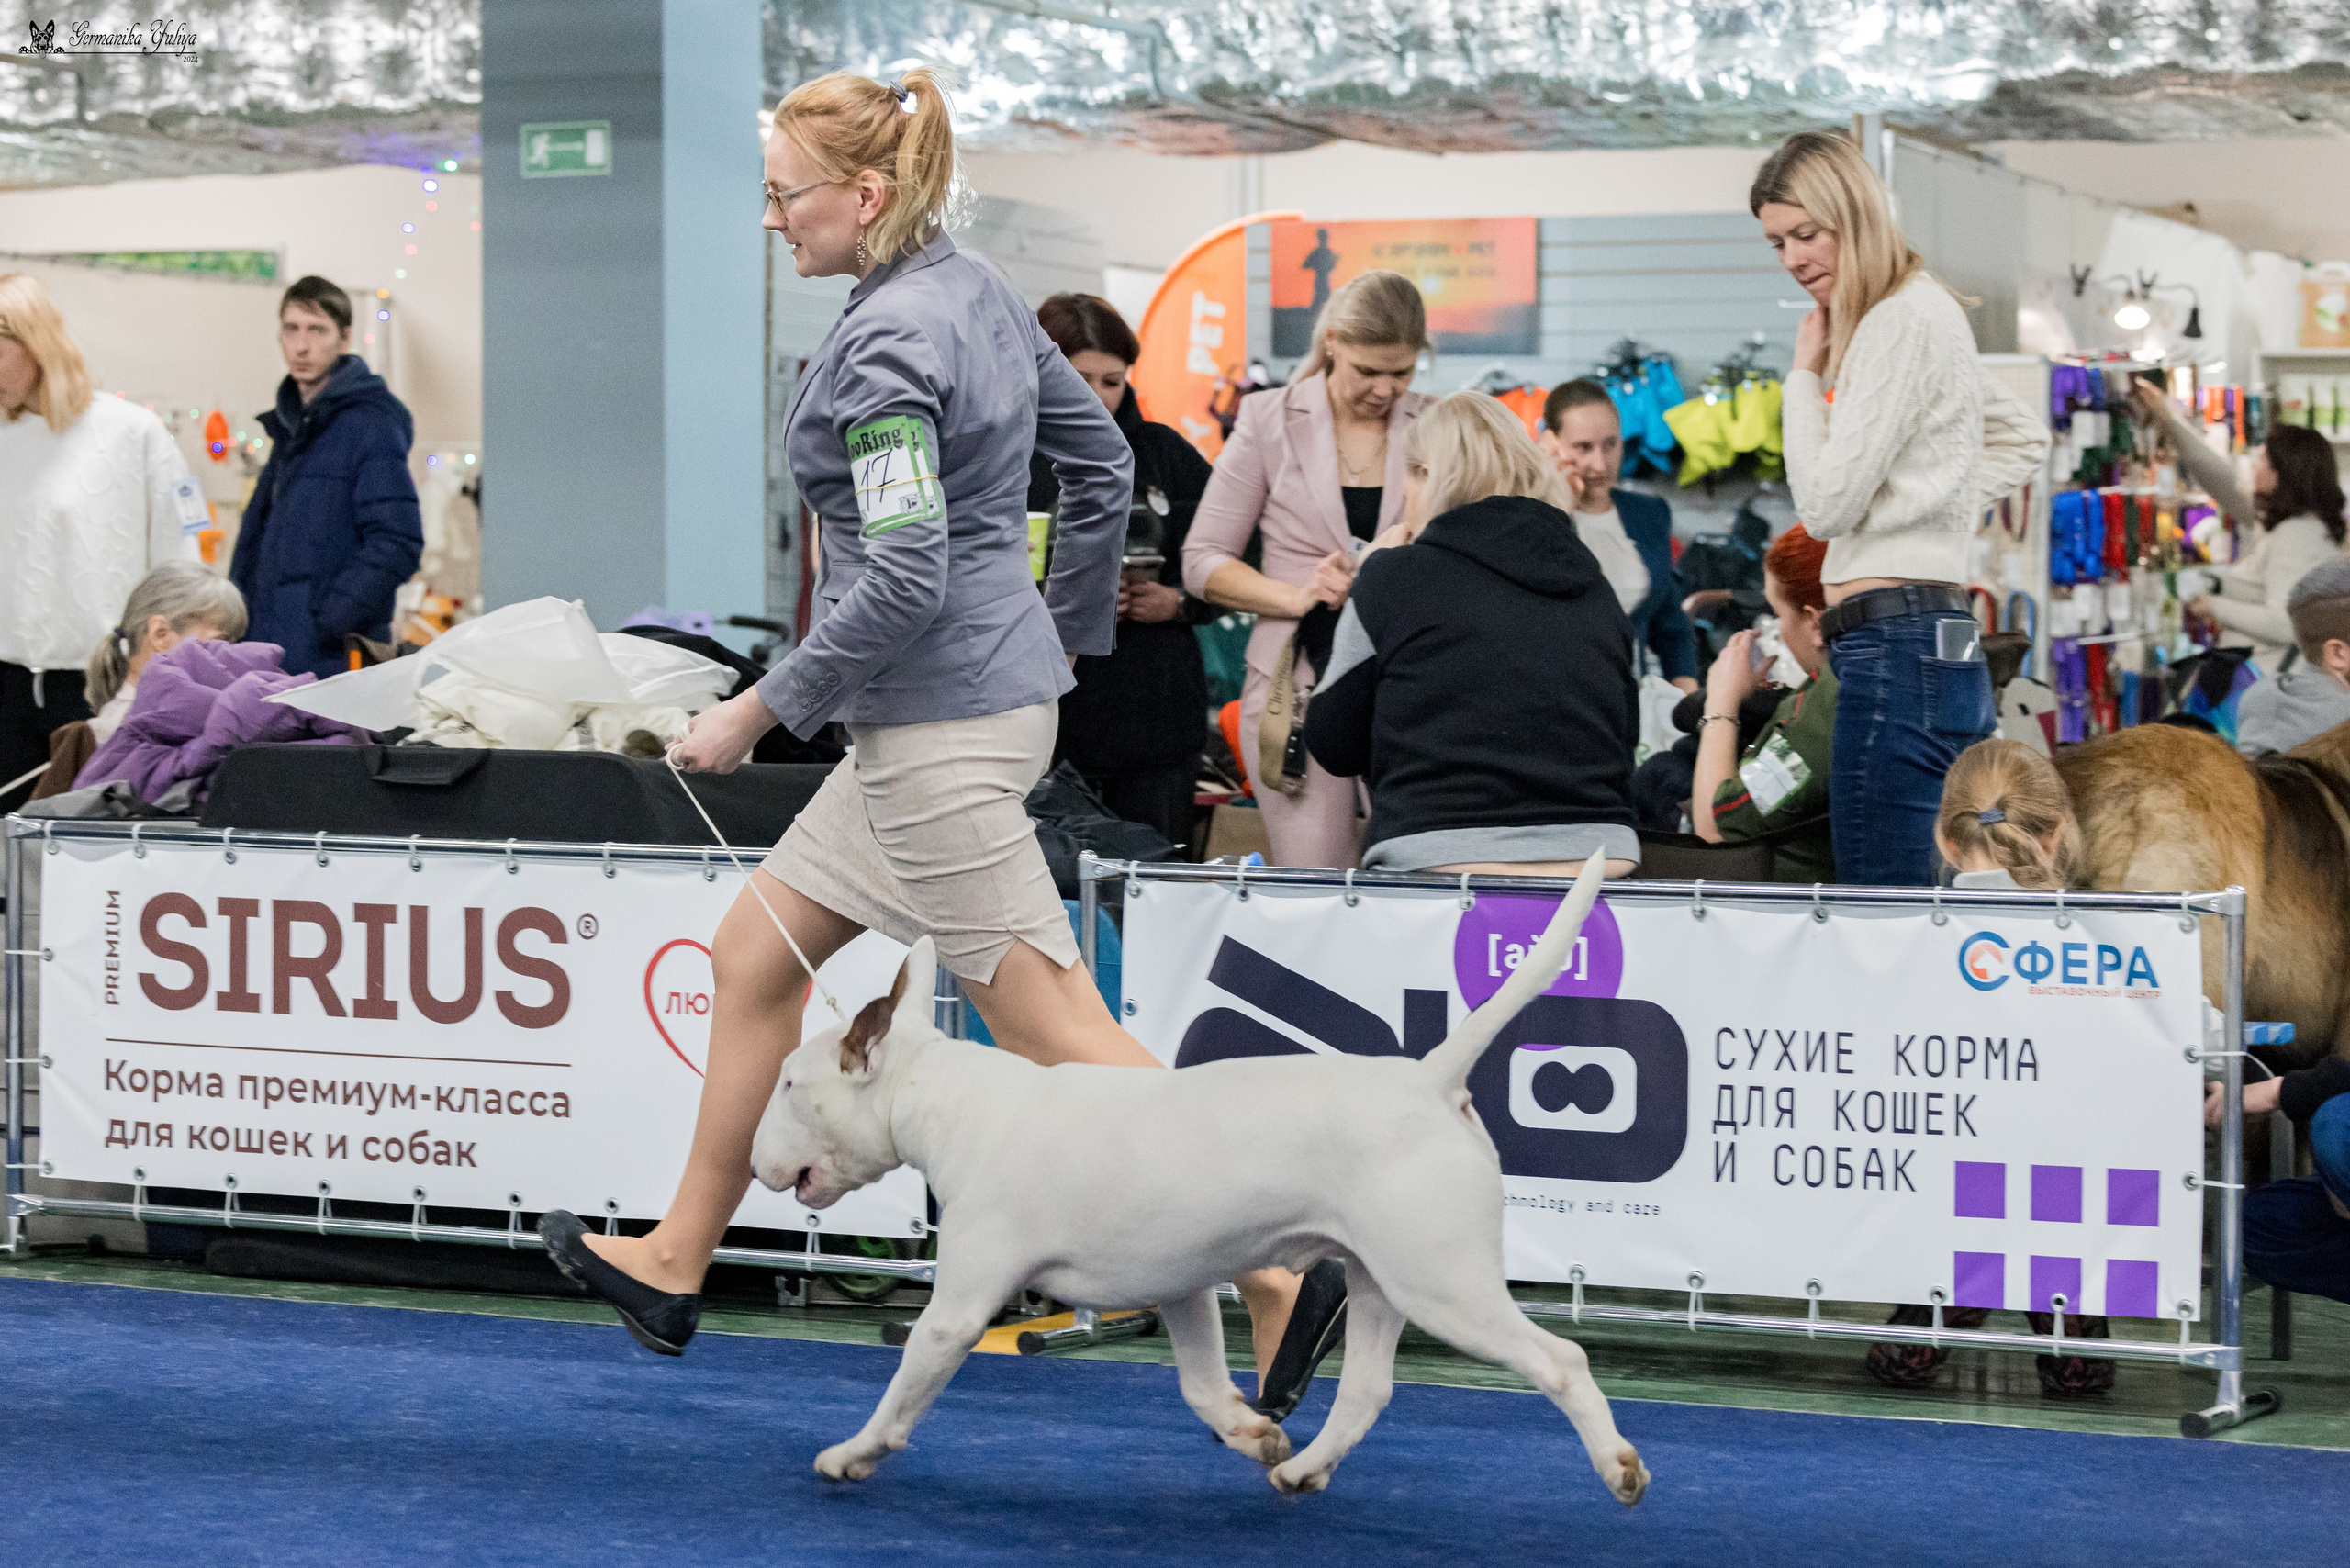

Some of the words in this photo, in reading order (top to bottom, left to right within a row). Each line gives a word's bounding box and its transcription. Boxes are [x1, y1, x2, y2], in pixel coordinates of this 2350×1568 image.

[104, 890, 122, 1006] PREMIUM
[1959, 931, 2160, 991] СФЕРА
[1716, 1026, 1855, 1074] СУХИЕ
[1894, 1034, 2040, 1081] КОРМА
[105, 1058, 224, 1103] Корма
[238, 1073, 572, 1119] премиум-класса
[1712, 1083, 1796, 1136] ДЛЯ
[1834, 1089, 1978, 1137] КОШЕК
[105, 1118, 174, 1150] для
[187, 1124, 314, 1158] кошек
[327, 1132, 349, 1160] и
[362, 1128, 479, 1169] собак
[1714, 1140, 1737, 1183] И
[1774, 1143, 1918, 1193] СОБАК
[1585, 1200, 1615, 1214] and
[1623, 1203, 1662, 1215] care
